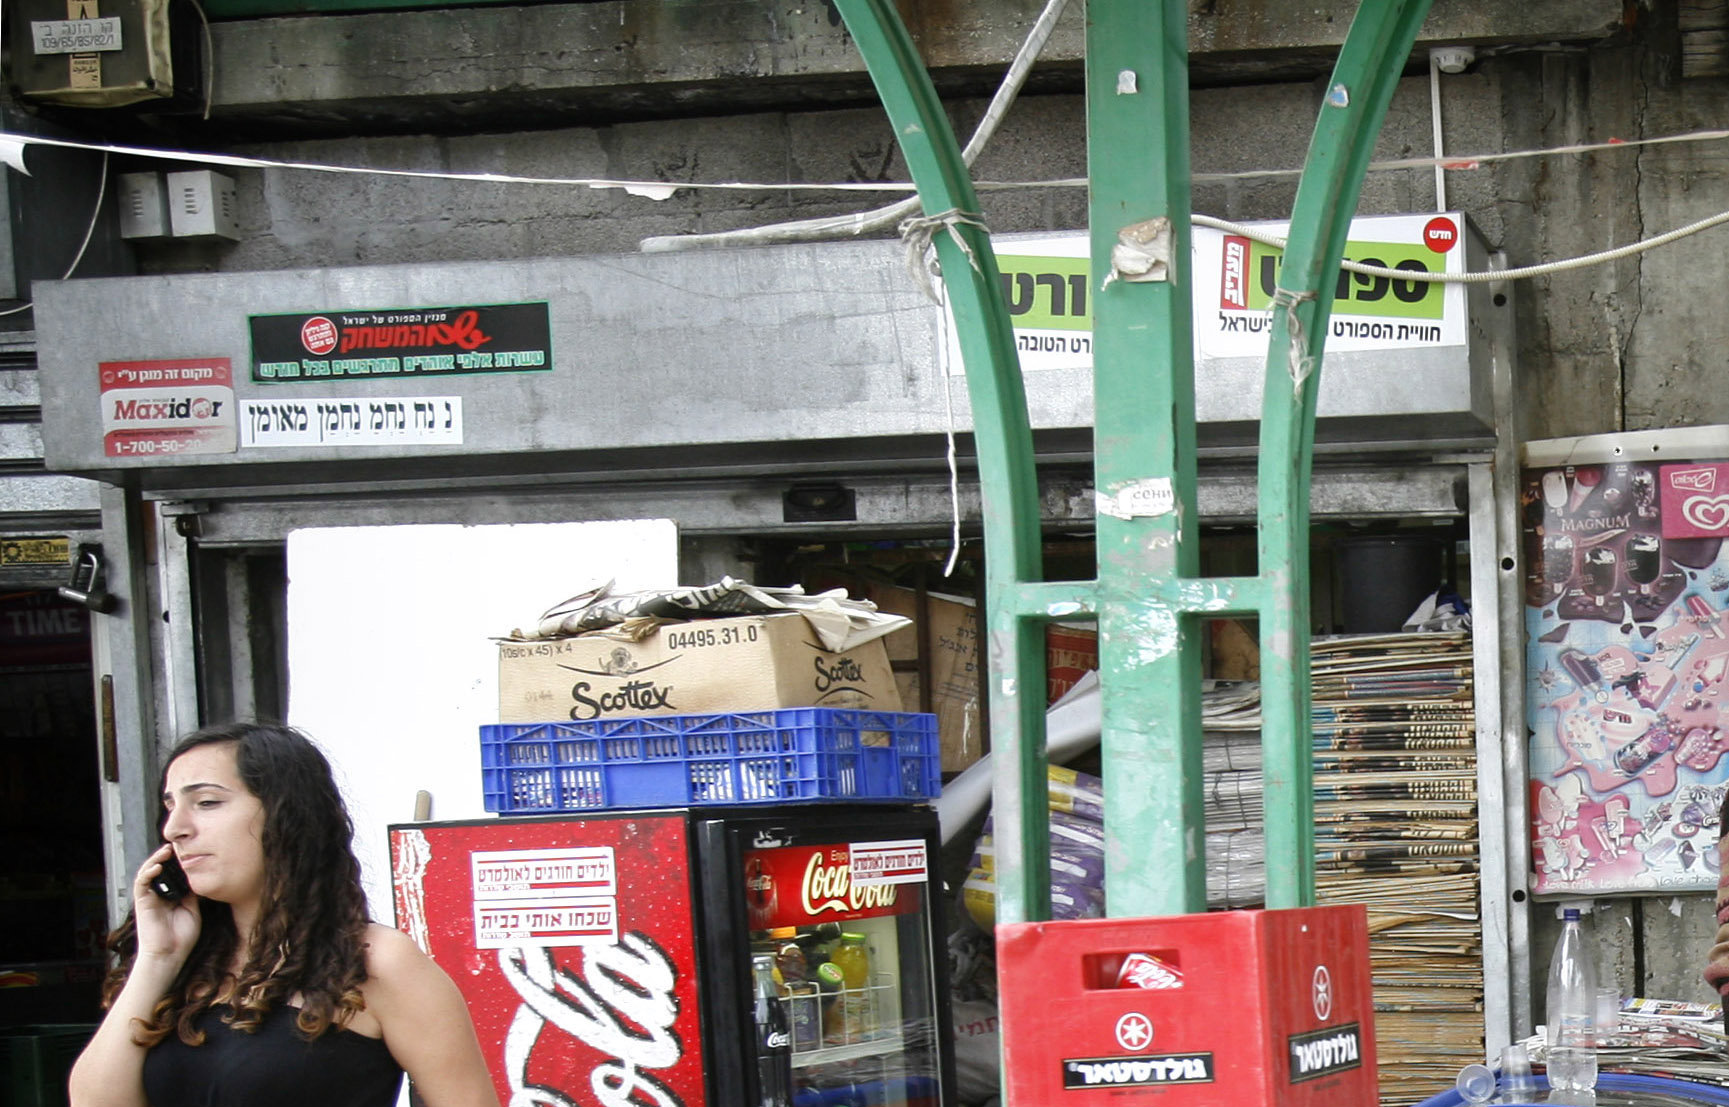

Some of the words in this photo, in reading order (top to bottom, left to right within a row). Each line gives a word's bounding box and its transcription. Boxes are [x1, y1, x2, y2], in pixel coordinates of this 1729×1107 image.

[1428, 228, 1453, 241] חדש
[342, 316, 370, 326] ישראל
[372, 315, 384, 325] של
[1333, 319, 1393, 339] הספורט
[1397, 323, 1441, 343] חוויית
[1018, 334, 1063, 353] הטובה
[139, 369, 162, 384] מוגן
[165, 369, 183, 381] זה
[186, 368, 213, 382] מקום
[1561, 512, 1632, 531] MAGNUM
[6, 608, 81, 636] TIME
[668, 625, 759, 651] 04495.31.0
[814, 655, 866, 692] Scottex
[570, 679, 676, 721] Scottex
[535, 865, 573, 881] חורגים
[577, 861, 610, 879] ילדים
[480, 914, 520, 929] בבית
[526, 913, 563, 928] אותי
[569, 911, 612, 926] שכחו
[1295, 1033, 1358, 1073] גולדסטאר
[1077, 1062, 1207, 1084] גולדסטאר
